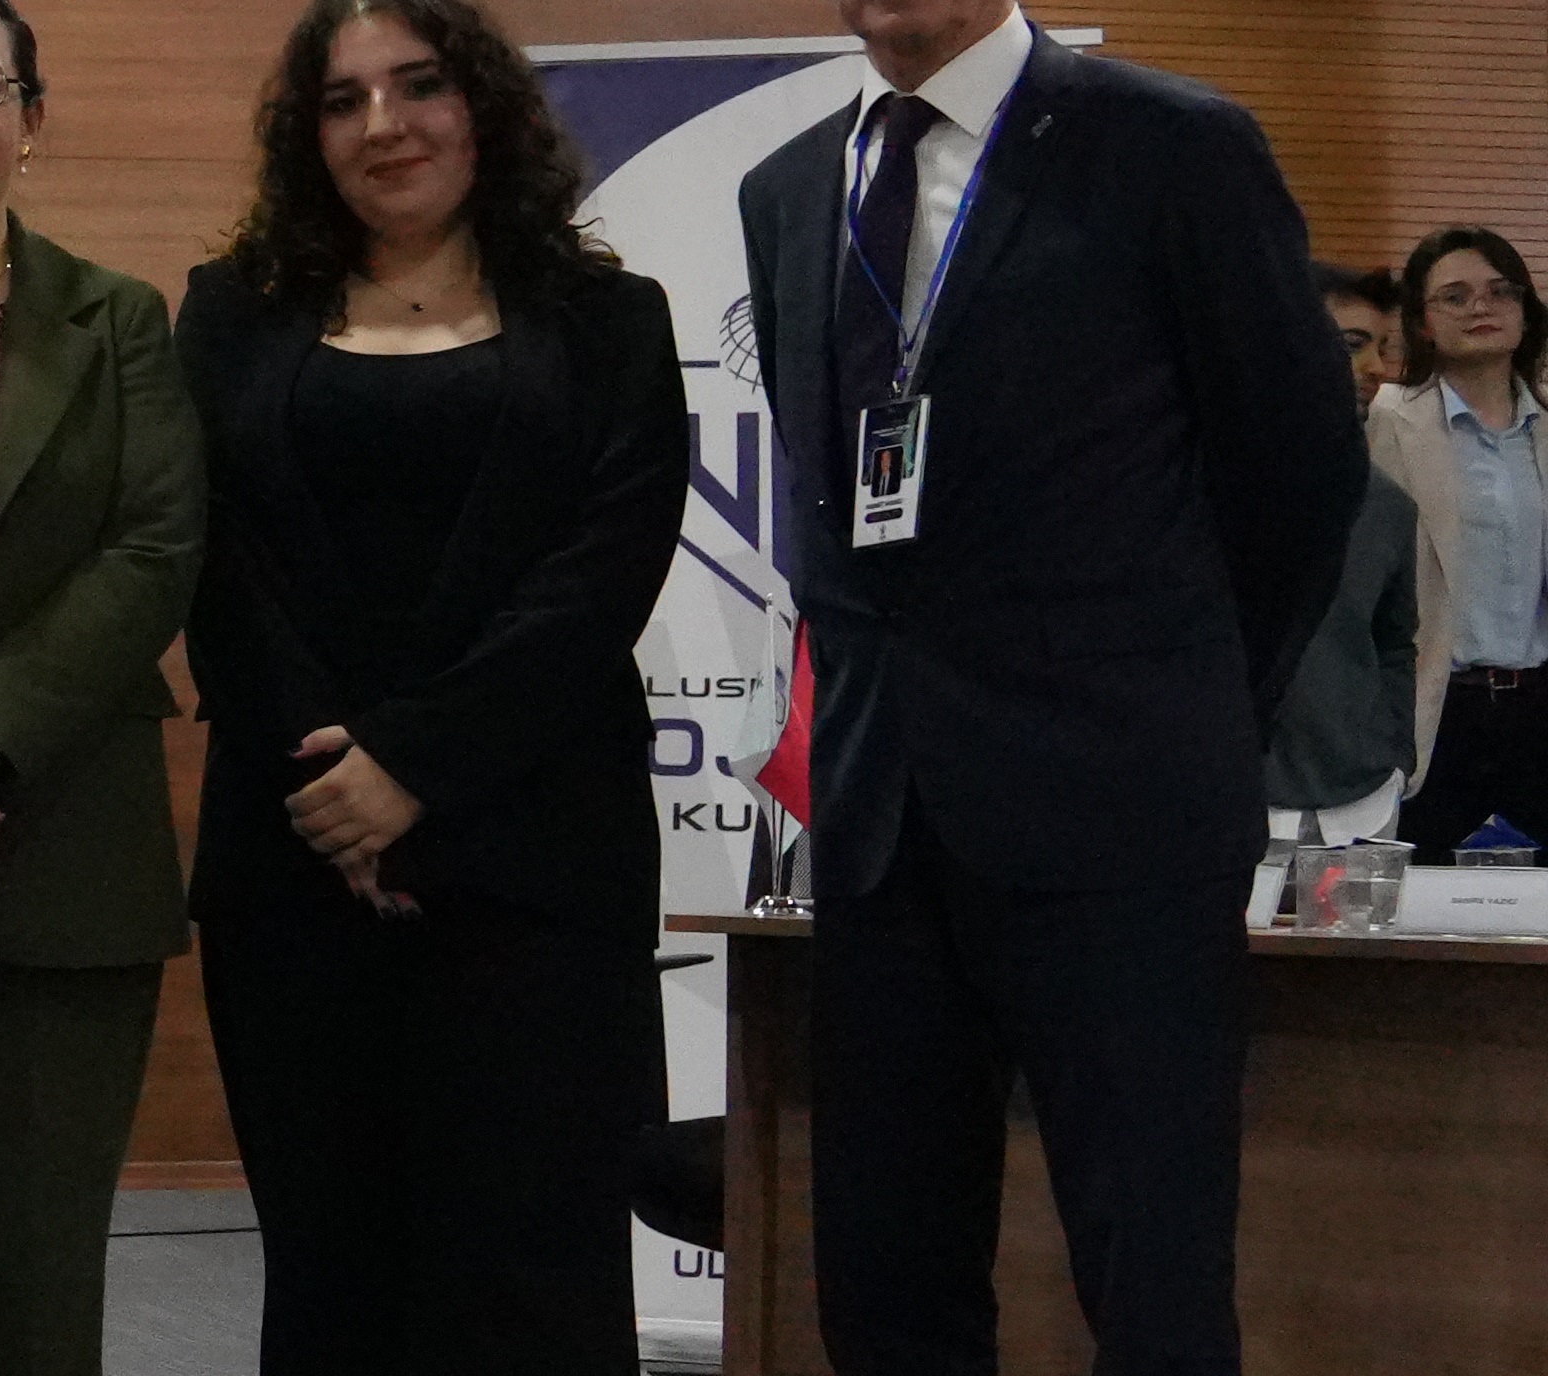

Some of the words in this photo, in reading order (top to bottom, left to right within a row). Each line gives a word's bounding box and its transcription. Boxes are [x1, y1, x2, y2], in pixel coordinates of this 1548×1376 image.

[646, 677, 756, 700] LUS
[673, 803, 752, 832] KU
[674, 1249, 725, 1279] UL
